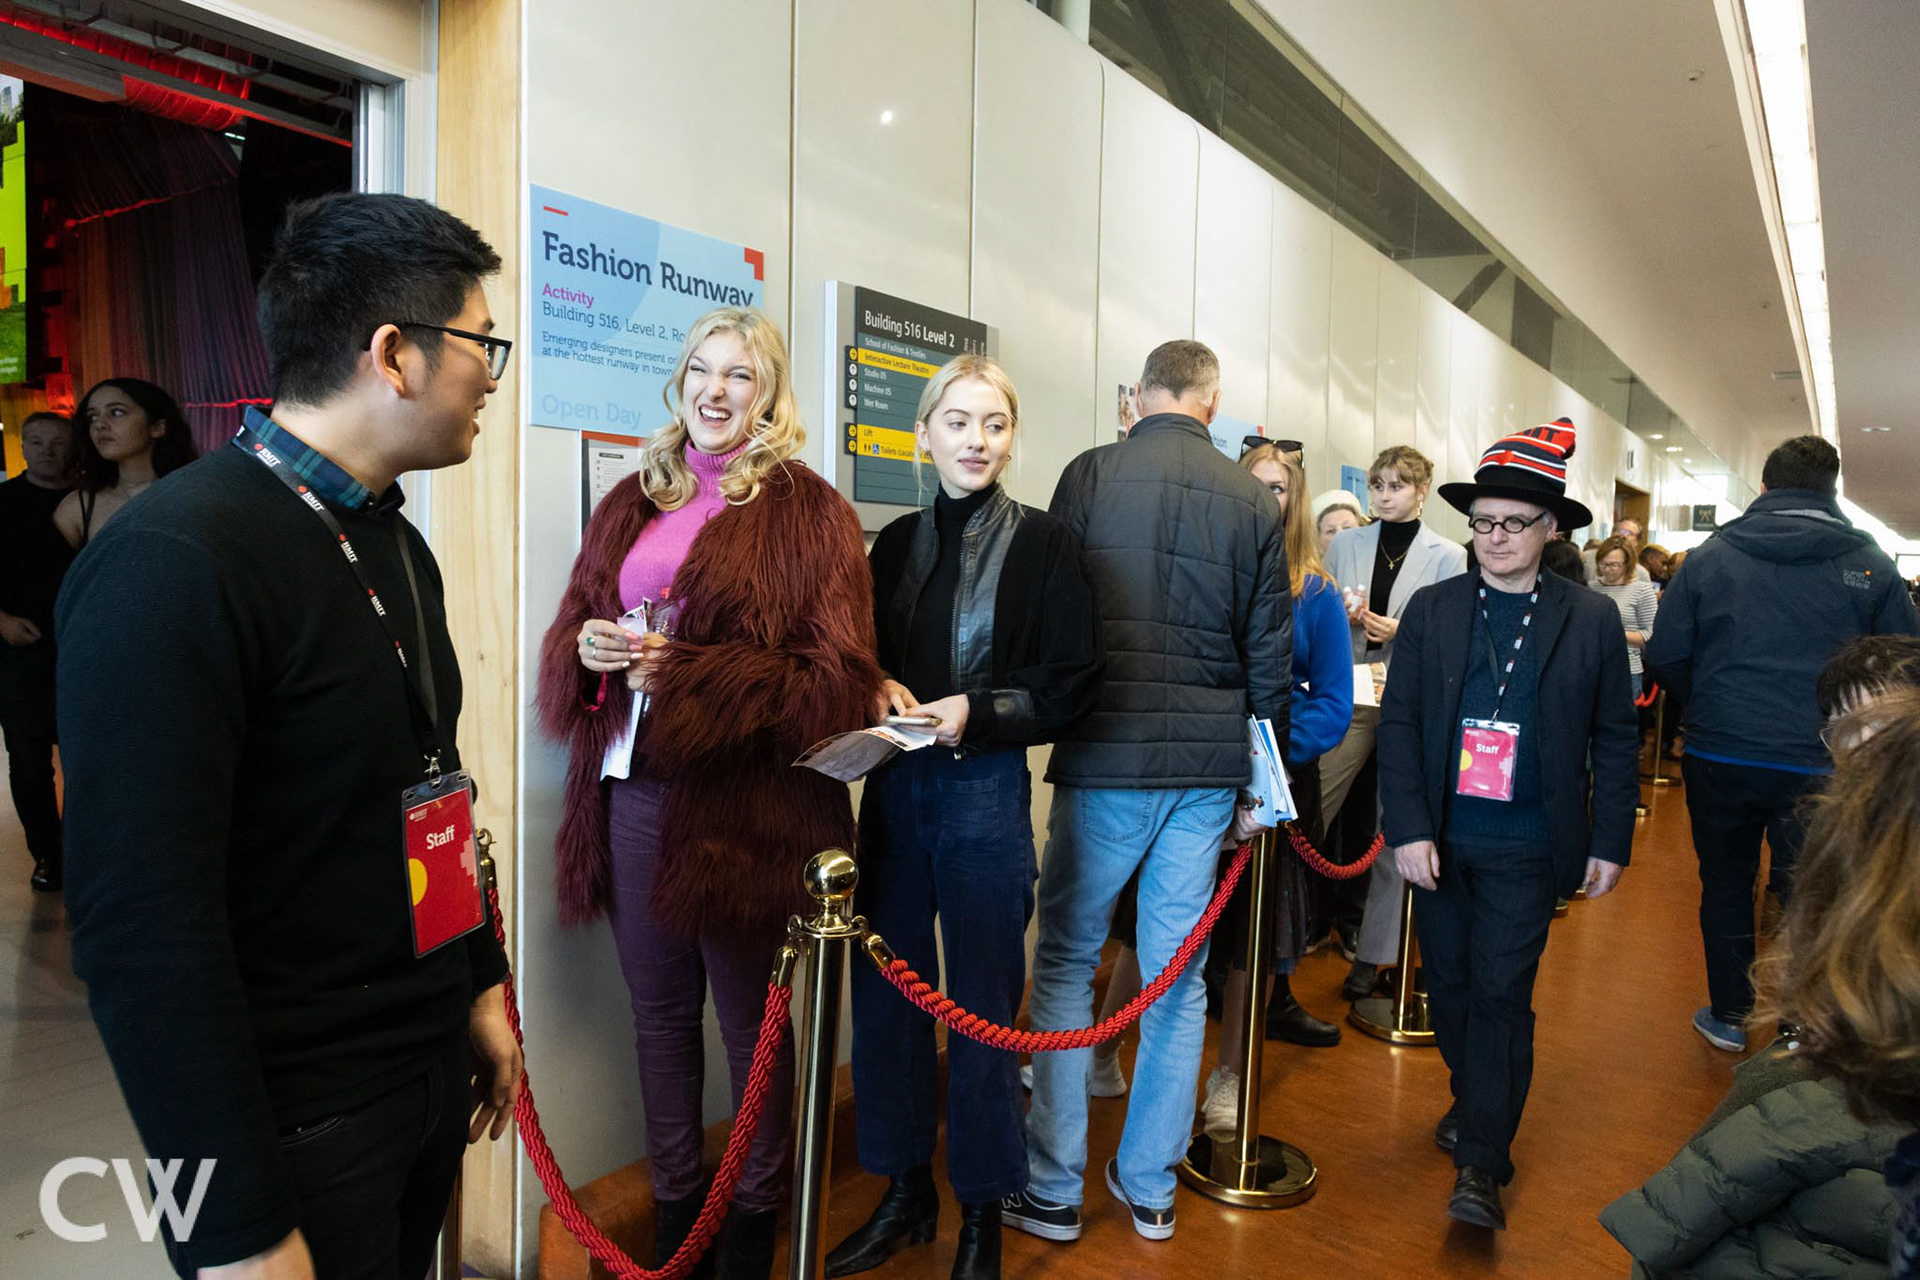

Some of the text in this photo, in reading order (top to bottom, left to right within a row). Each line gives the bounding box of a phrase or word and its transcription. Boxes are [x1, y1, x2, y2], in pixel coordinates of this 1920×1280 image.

[543, 230, 753, 307] Fashion Runway
[543, 283, 594, 309] Activity
[543, 301, 595, 328] Building
[599, 313, 621, 331] 516,
[625, 318, 655, 337] Level
[865, 310, 902, 338] Building
[904, 321, 921, 339] 516
[923, 326, 947, 346] Level
[949, 333, 955, 348] 2
[542, 331, 587, 351] Emerging
[590, 340, 632, 356] designers
[635, 349, 666, 364] present
[865, 337, 881, 348] School
[888, 341, 905, 353] Fashion
[542, 346, 552, 356] at
[555, 346, 570, 360] the
[573, 349, 604, 366] hottest
[607, 358, 639, 374] runway
[642, 363, 650, 373] in
[864, 367, 879, 378] Studio
[865, 353, 892, 366] Interactive
[893, 357, 910, 369] Lecture
[864, 383, 884, 394] Machine
[542, 394, 642, 429] Open Day
[875, 400, 889, 410] Room
[864, 428, 873, 437] Lift
[1476, 743, 1499, 754] Staff
[426, 825, 455, 850] Staff
